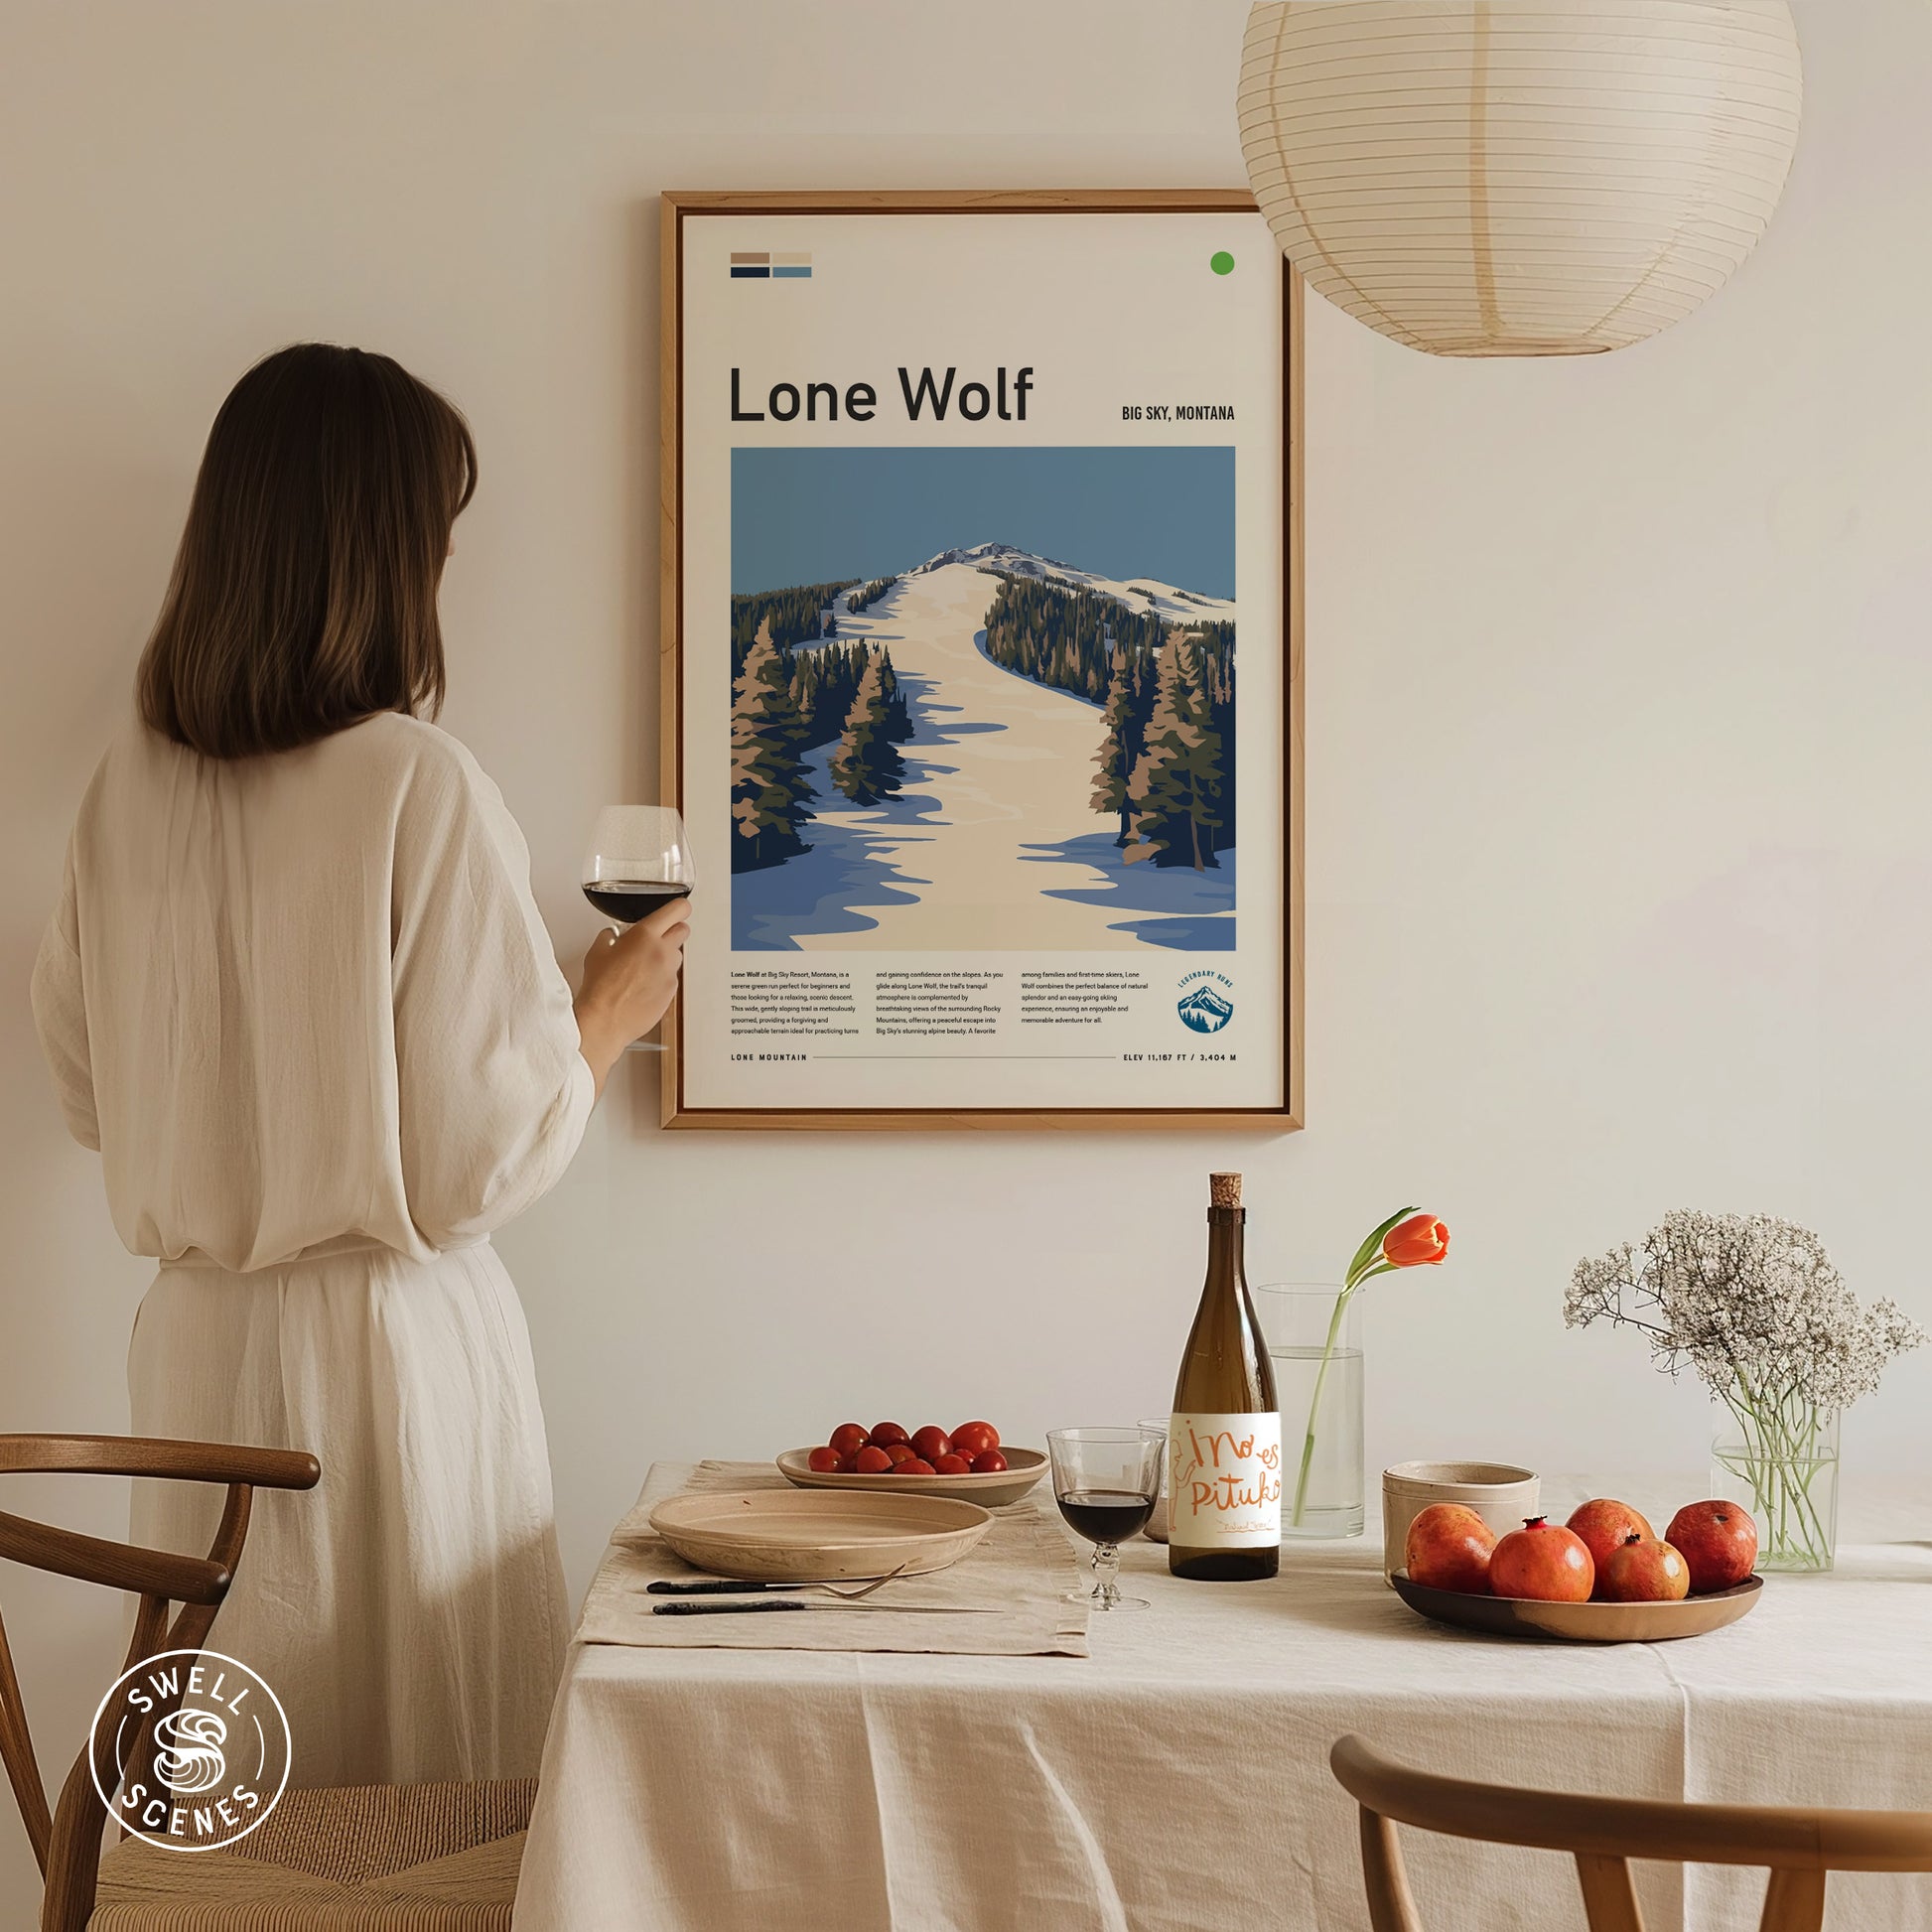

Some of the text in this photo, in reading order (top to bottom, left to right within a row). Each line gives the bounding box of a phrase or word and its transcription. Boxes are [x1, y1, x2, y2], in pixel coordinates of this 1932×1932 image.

[730, 365, 1035, 423] Lone Wolf
[1121, 404, 1236, 424] BIG SKY, MONTANA
[767, 971, 777, 980] Big
[778, 971, 789, 980] Sky
[889, 971, 909, 980] gaining
[1177, 970, 1233, 988] LEGENDARY RUNS
[749, 994, 769, 1003] looking
[876, 994, 910, 1003] atmosphere
[917, 994, 960, 1003] complemented
[961, 994, 968, 1003] by
[1022, 994, 1046, 1003] splendor
[1100, 994, 1117, 1003] skiing
[731, 1028, 769, 1036] approachable
[815, 1028, 843, 1036] practicing
[876, 1028, 886, 1036] Big
[902, 1028, 927, 1036] stunning
[928, 1028, 945, 1036] alpine
